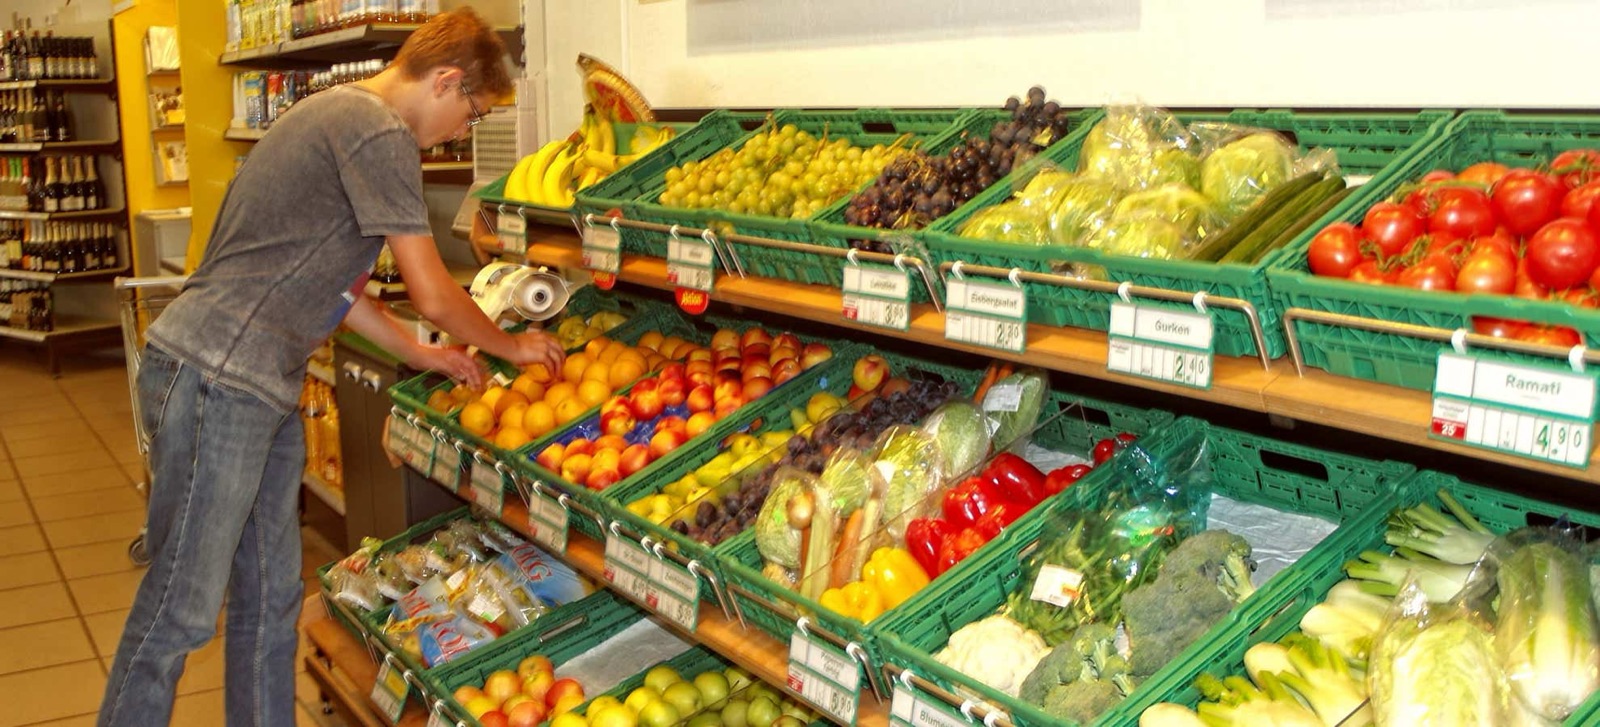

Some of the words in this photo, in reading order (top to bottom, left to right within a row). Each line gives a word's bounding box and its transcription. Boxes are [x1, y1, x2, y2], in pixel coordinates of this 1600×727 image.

[1155, 320, 1190, 336] Gurken
[1505, 374, 1562, 395] Ramati
[1441, 423, 1456, 436] 25
[1537, 424, 1582, 455] 4.90
